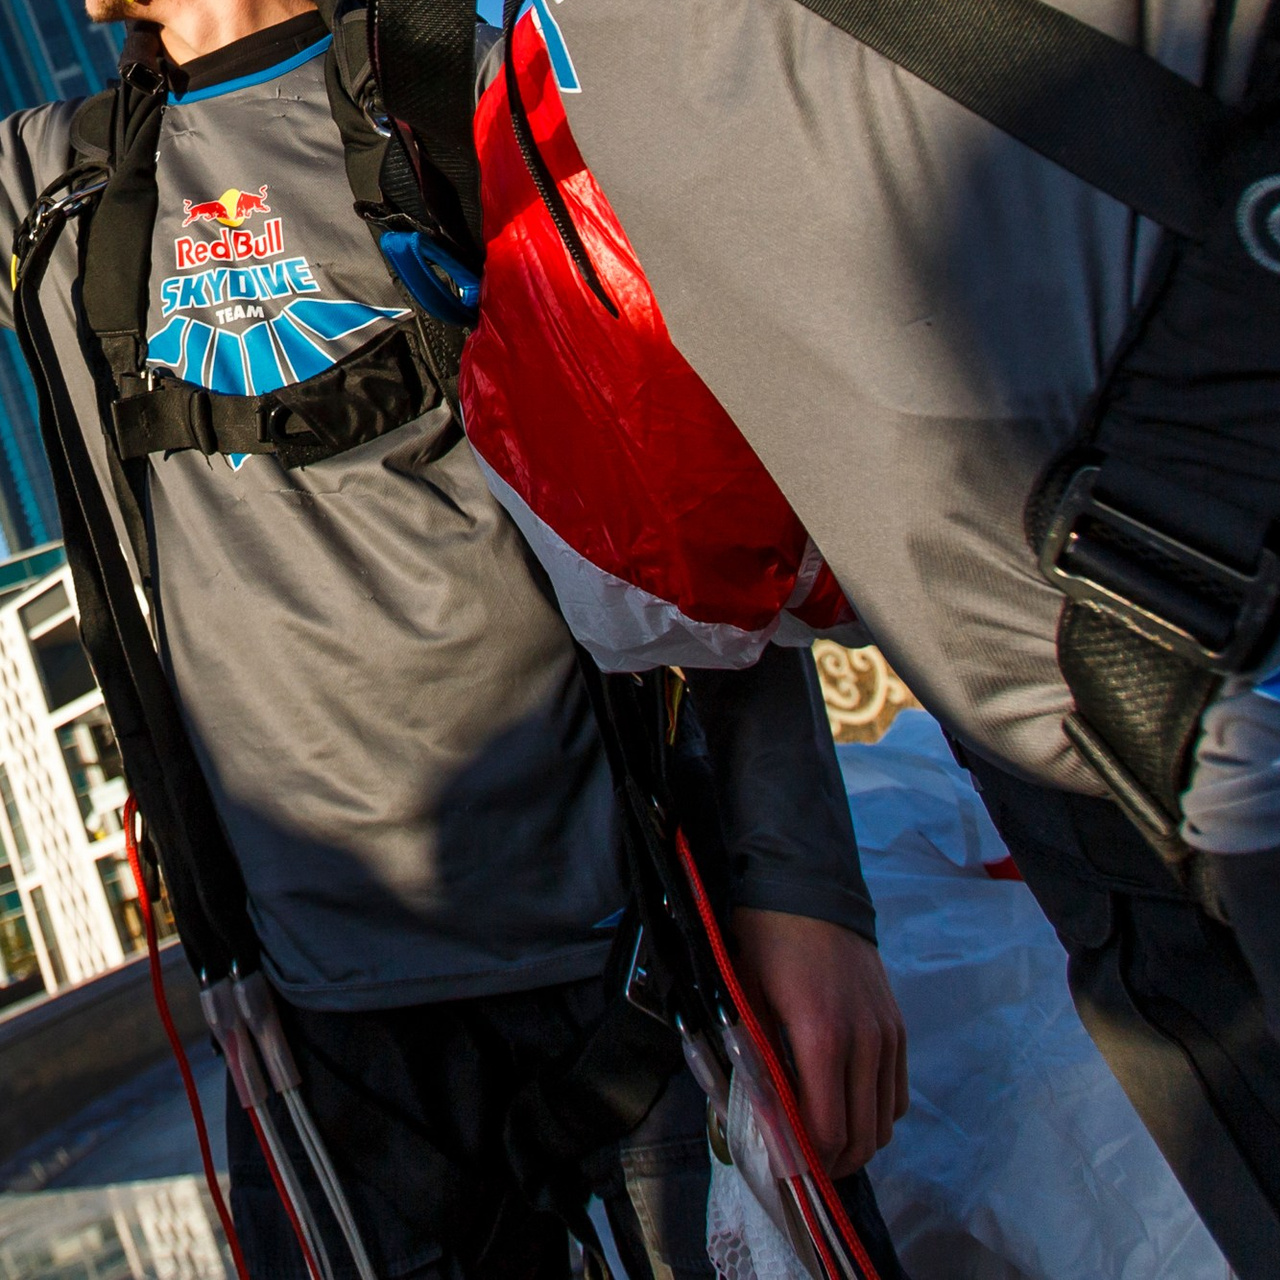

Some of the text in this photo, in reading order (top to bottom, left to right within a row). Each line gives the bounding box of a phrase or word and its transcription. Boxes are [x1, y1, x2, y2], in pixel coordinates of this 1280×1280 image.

[176, 219, 283, 269] Red Bull
[161, 257, 320, 318] SKYDIVE
[216, 306, 264, 325] TEAM
